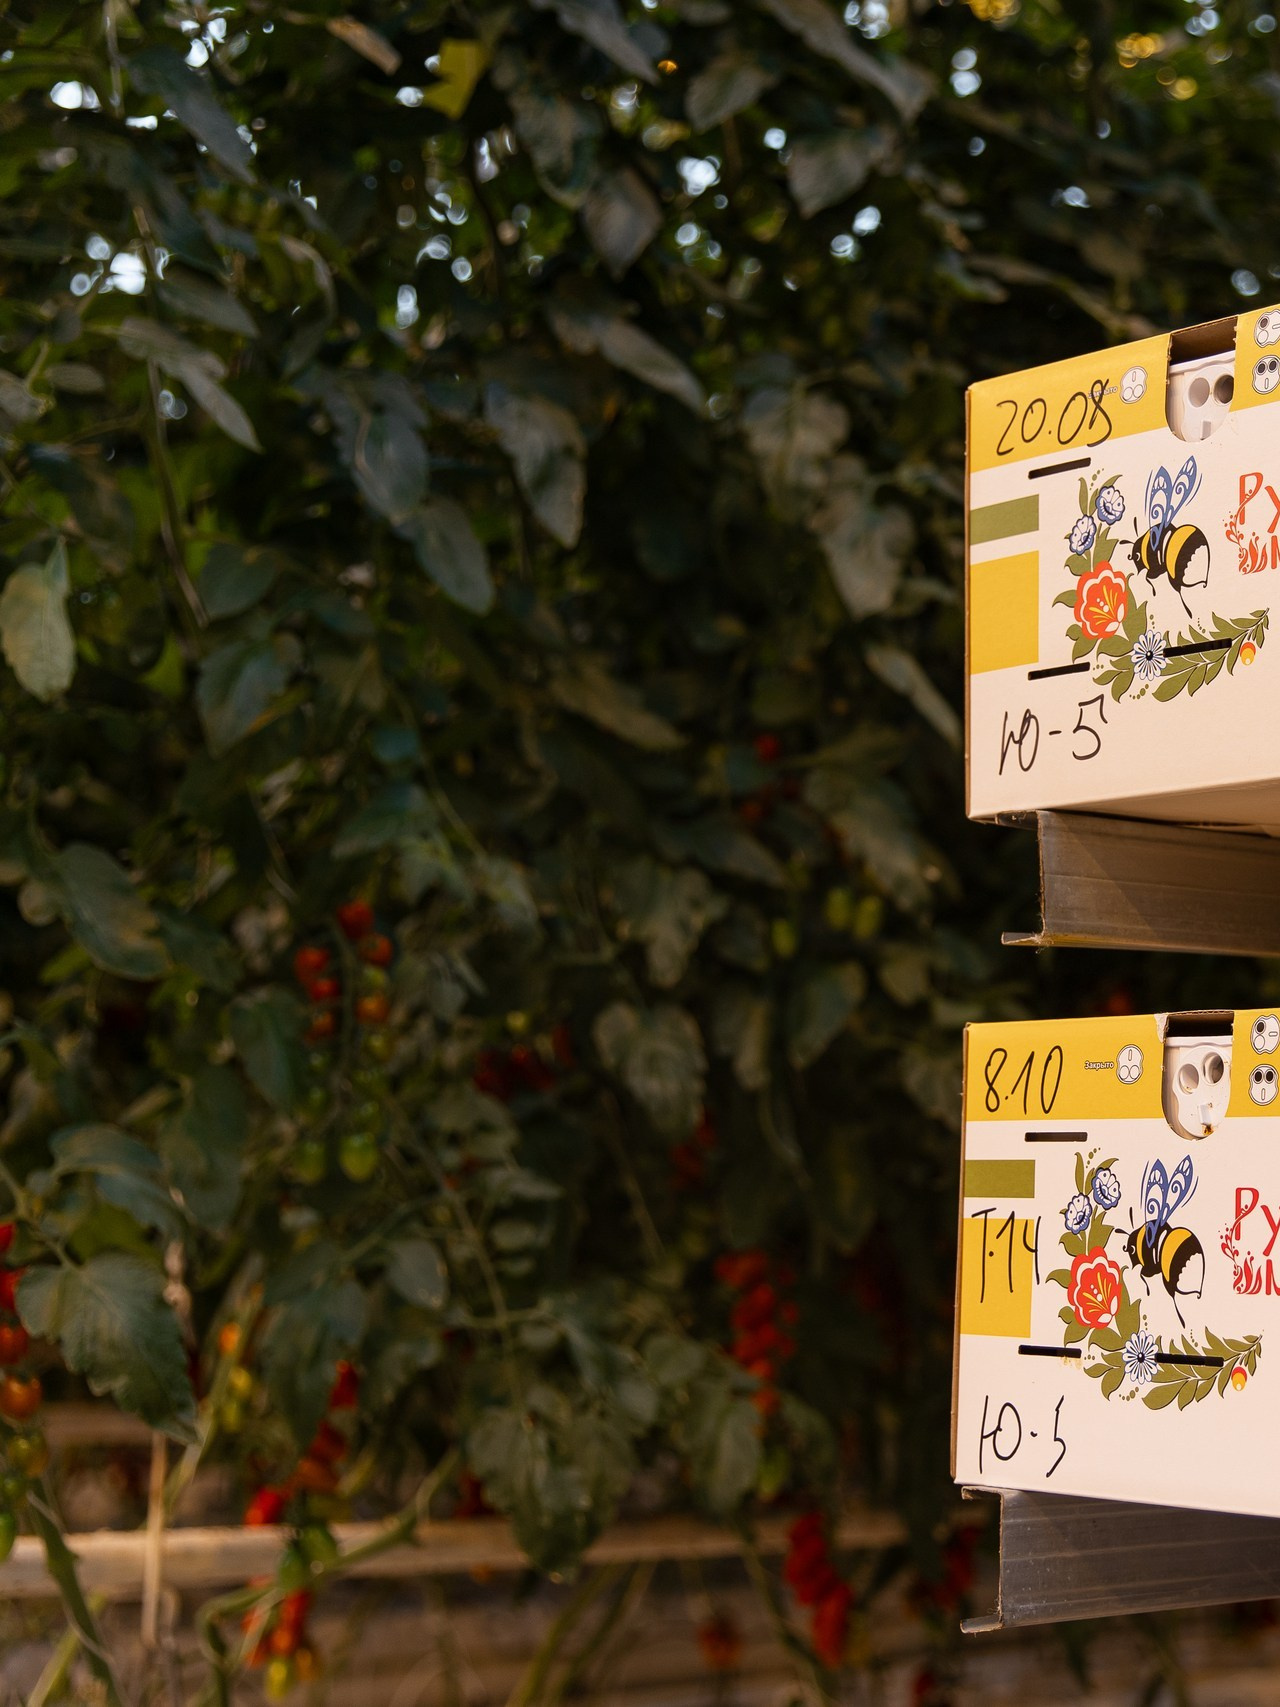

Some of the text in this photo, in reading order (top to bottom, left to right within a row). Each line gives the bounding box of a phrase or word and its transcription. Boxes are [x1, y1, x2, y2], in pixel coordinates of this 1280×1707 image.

[995, 378, 1113, 457] 20.08
[983, 1045, 1064, 1115] 8.10
[1084, 1060, 1115, 1071] Закрыто
